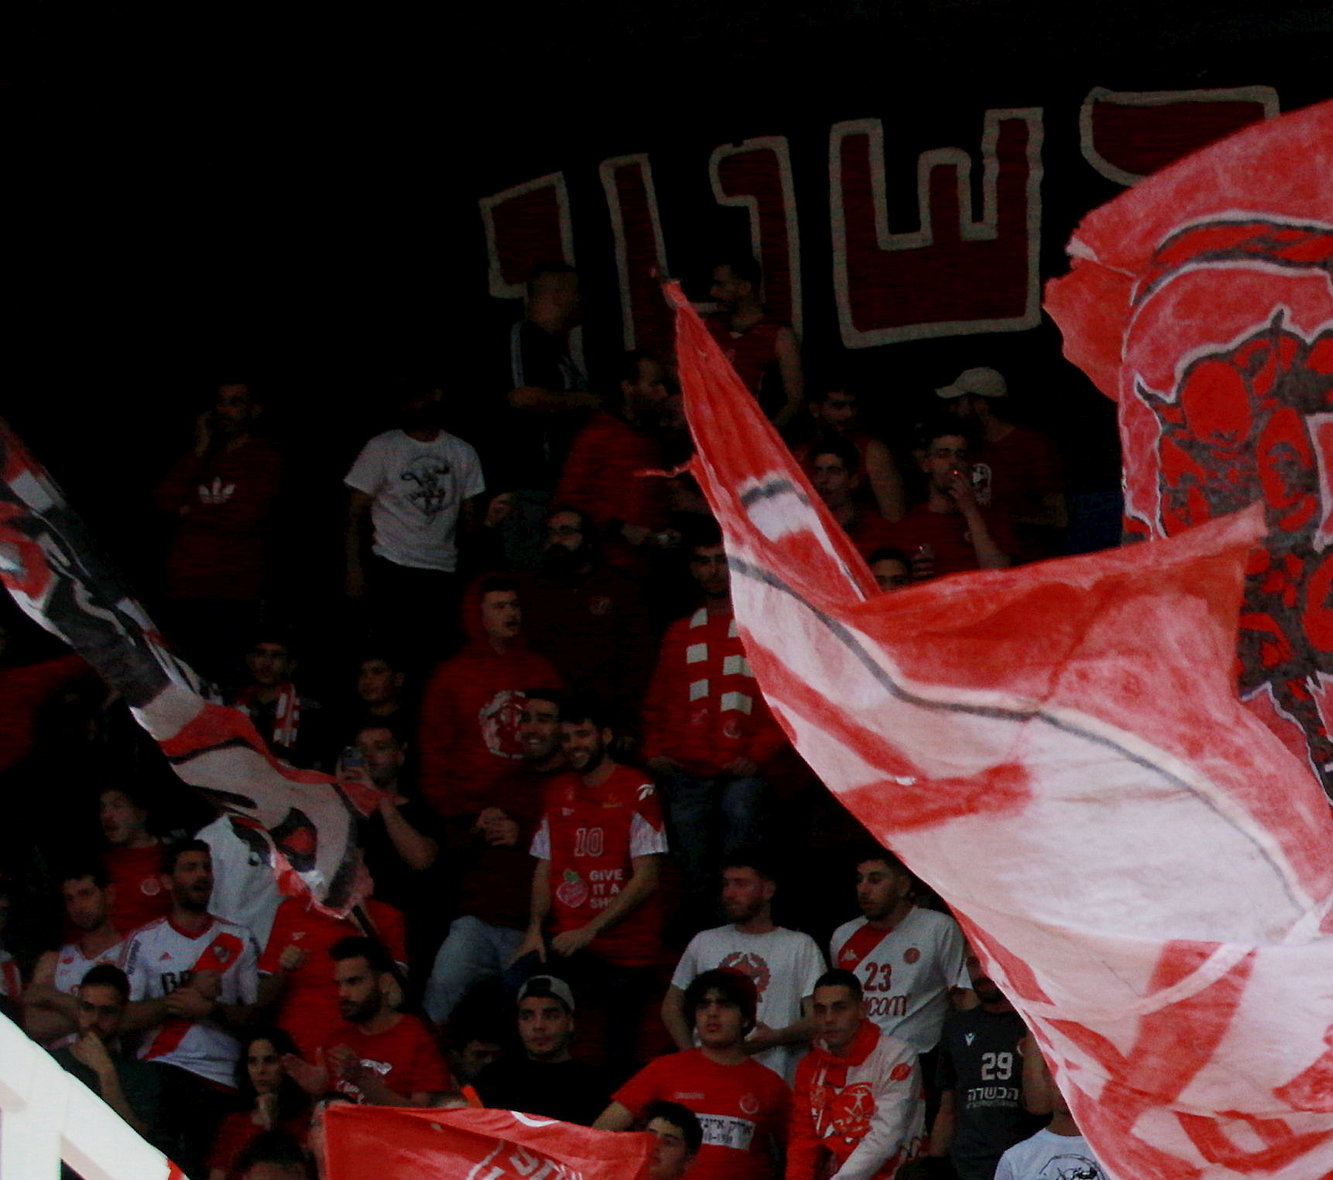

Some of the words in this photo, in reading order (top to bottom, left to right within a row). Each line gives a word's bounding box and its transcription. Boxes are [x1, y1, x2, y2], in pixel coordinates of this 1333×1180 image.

[572, 826, 605, 859] 10
[588, 869, 624, 884] GIVE
[863, 962, 894, 993] 23
[980, 1052, 1013, 1081] 29
[967, 1086, 1019, 1103] הכשרה
